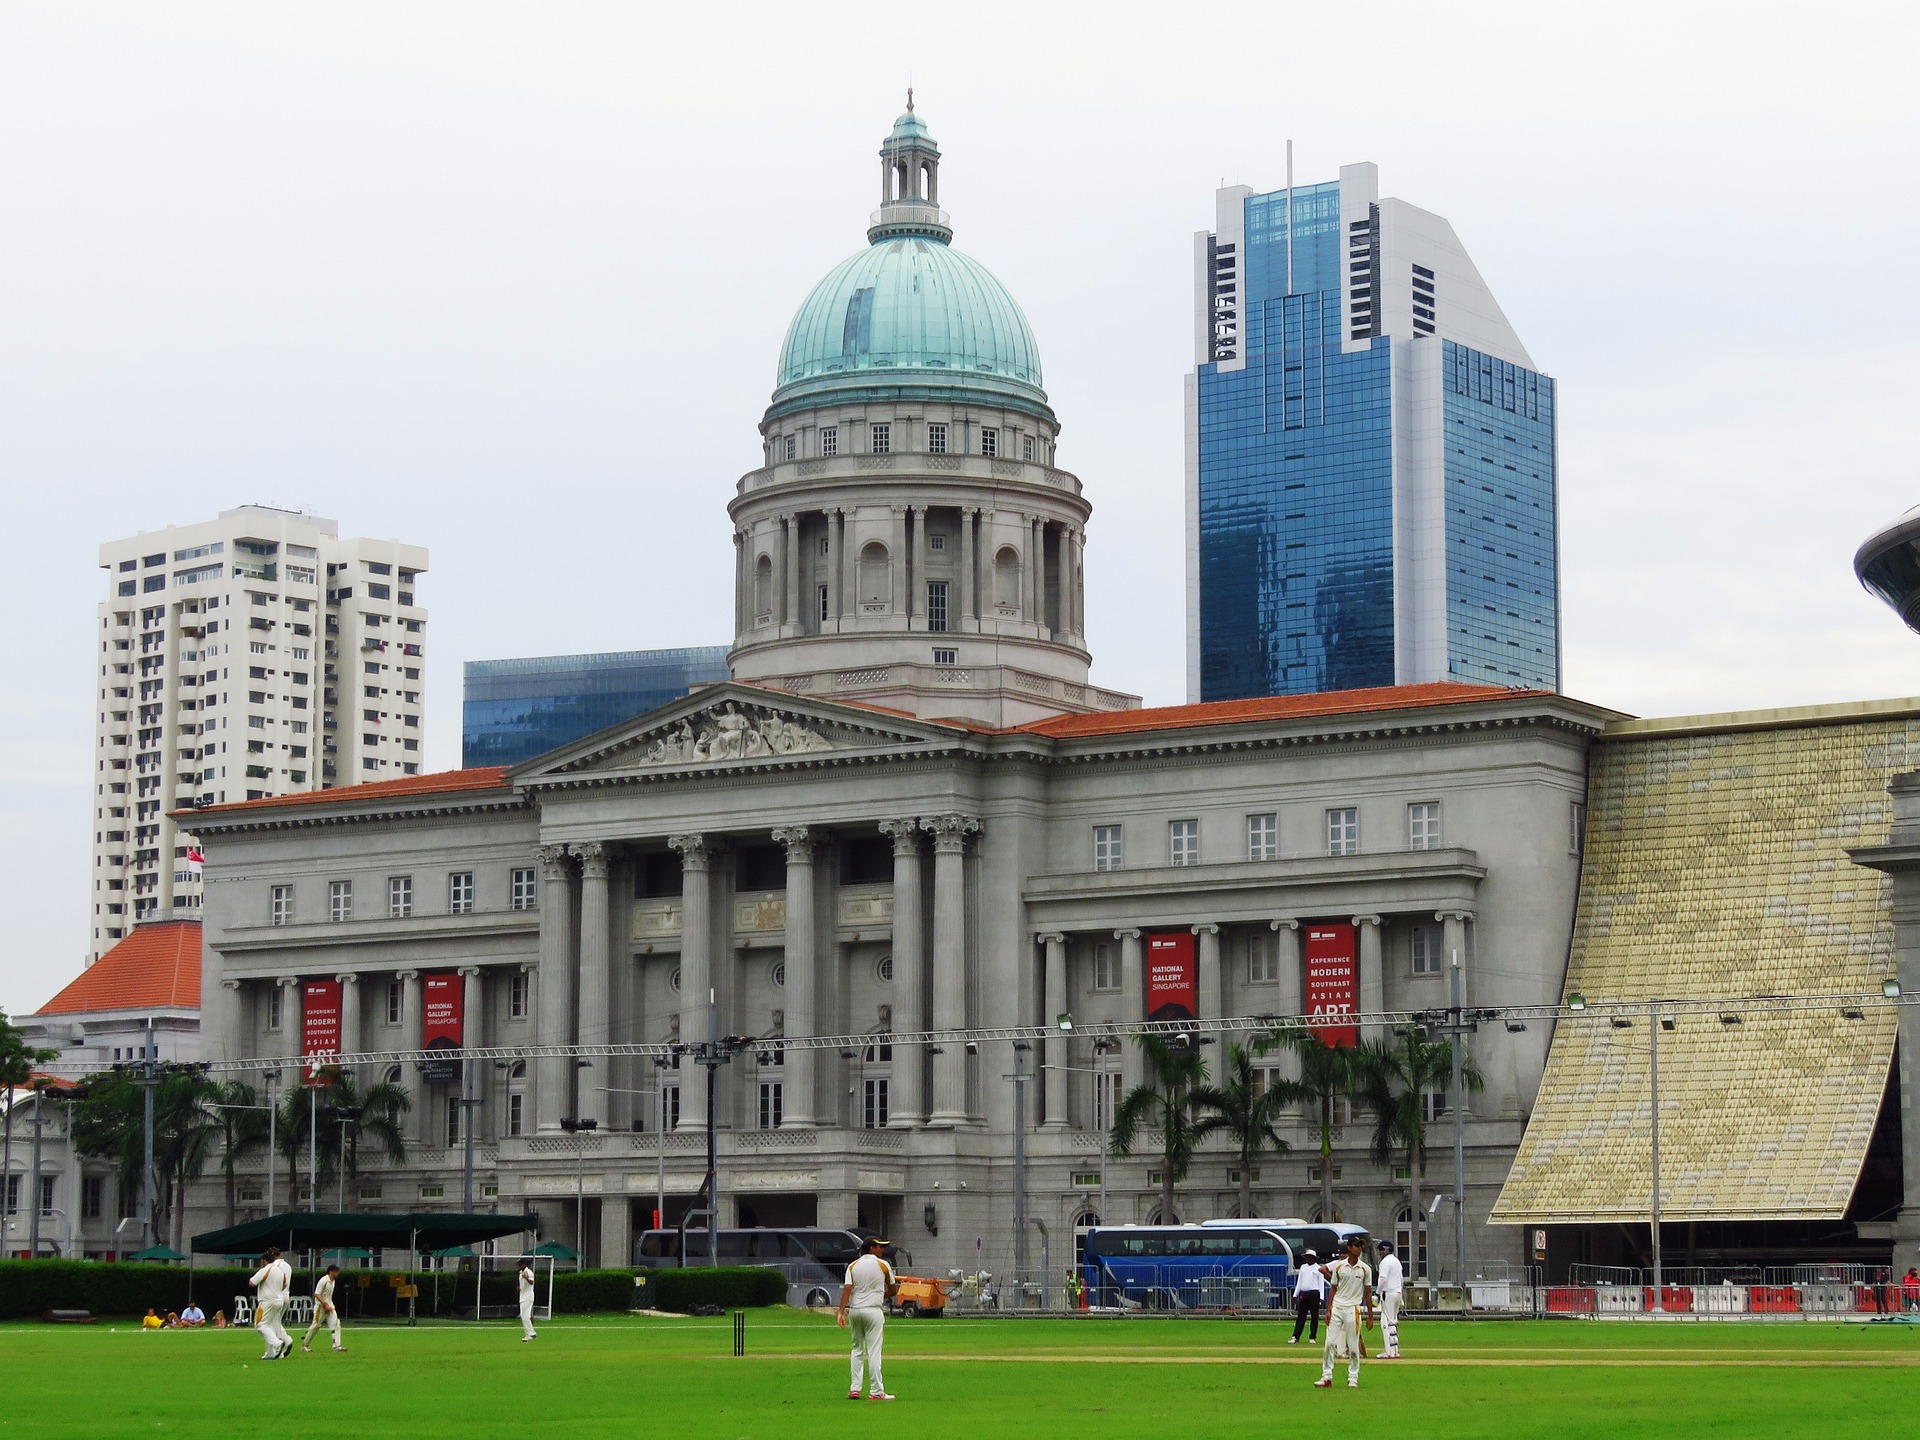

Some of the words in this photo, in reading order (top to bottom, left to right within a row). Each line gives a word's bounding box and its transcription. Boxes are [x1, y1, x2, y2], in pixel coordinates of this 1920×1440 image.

[1310, 956, 1350, 964] EXPERIENCE
[1152, 965, 1184, 973] NATIONAL
[1310, 967, 1351, 977] MODERN
[1152, 974, 1182, 982] GALLERY
[1152, 982, 1190, 991] SINGAPORE
[1311, 980, 1351, 988] SOUTHEAST
[1311, 991, 1351, 1000] ASIAN
[1312, 1003, 1351, 1023] ART
